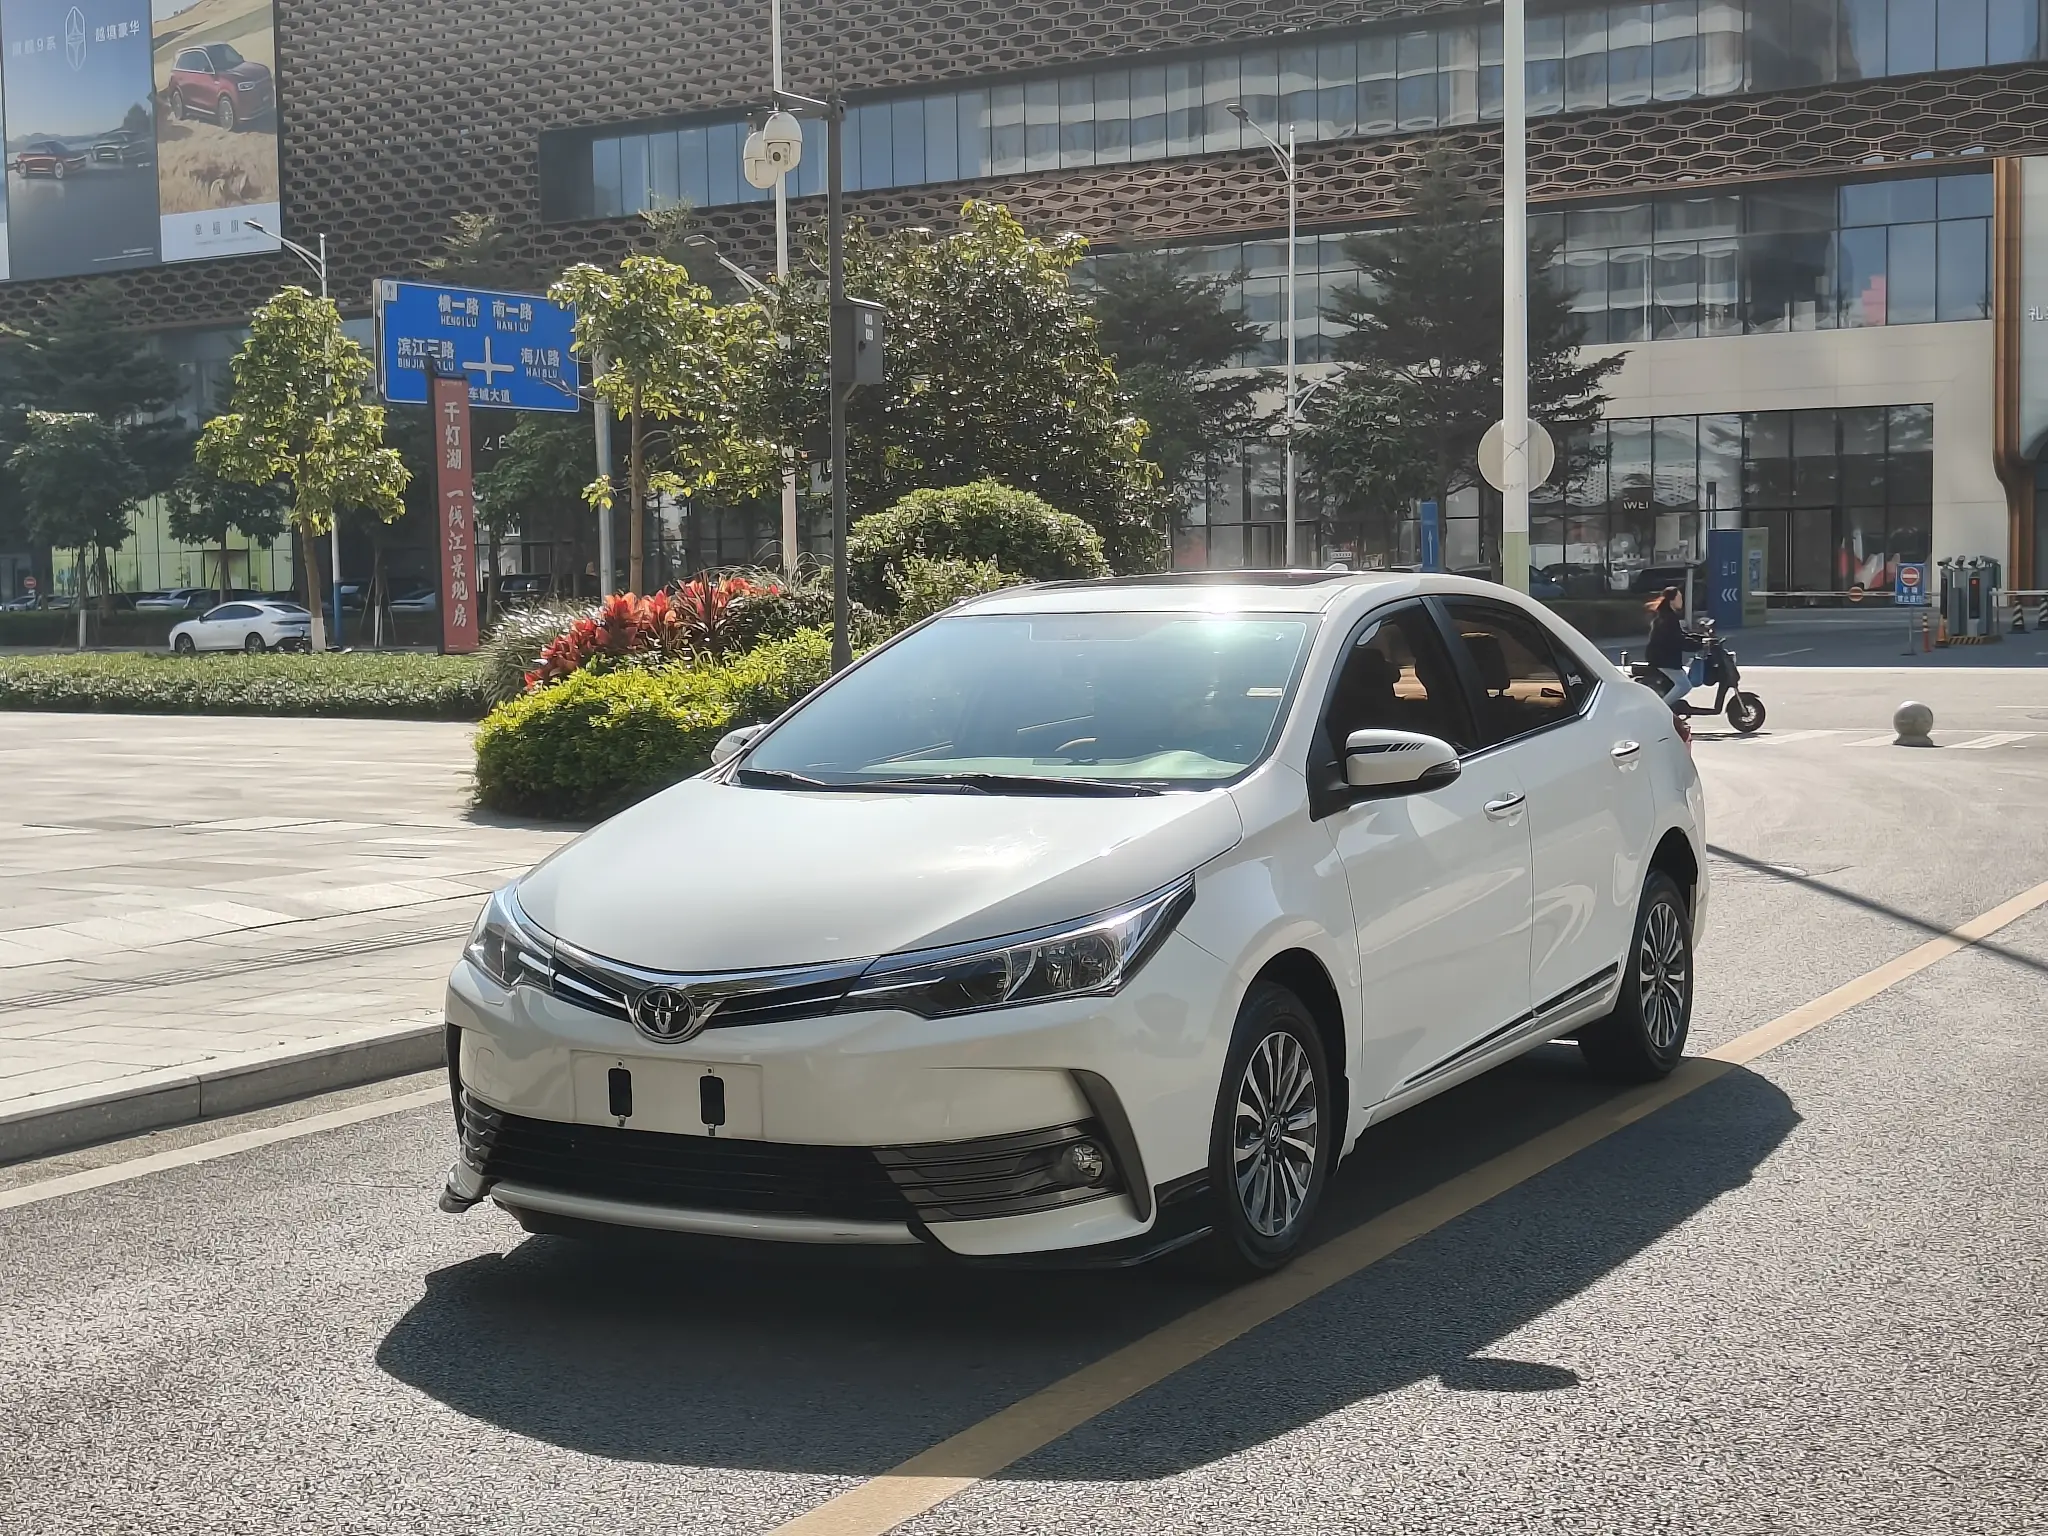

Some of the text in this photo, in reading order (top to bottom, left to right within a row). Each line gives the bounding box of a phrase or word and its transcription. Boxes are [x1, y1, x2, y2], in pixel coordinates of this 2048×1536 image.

[437, 293, 533, 322] 横一路 南一路
[397, 337, 455, 360] 滨江三路
[520, 347, 560, 368] 海八路
[468, 386, 511, 403] 车城大道
[444, 401, 463, 470] 千灯湖
[446, 489, 469, 628] 一线江景现房
